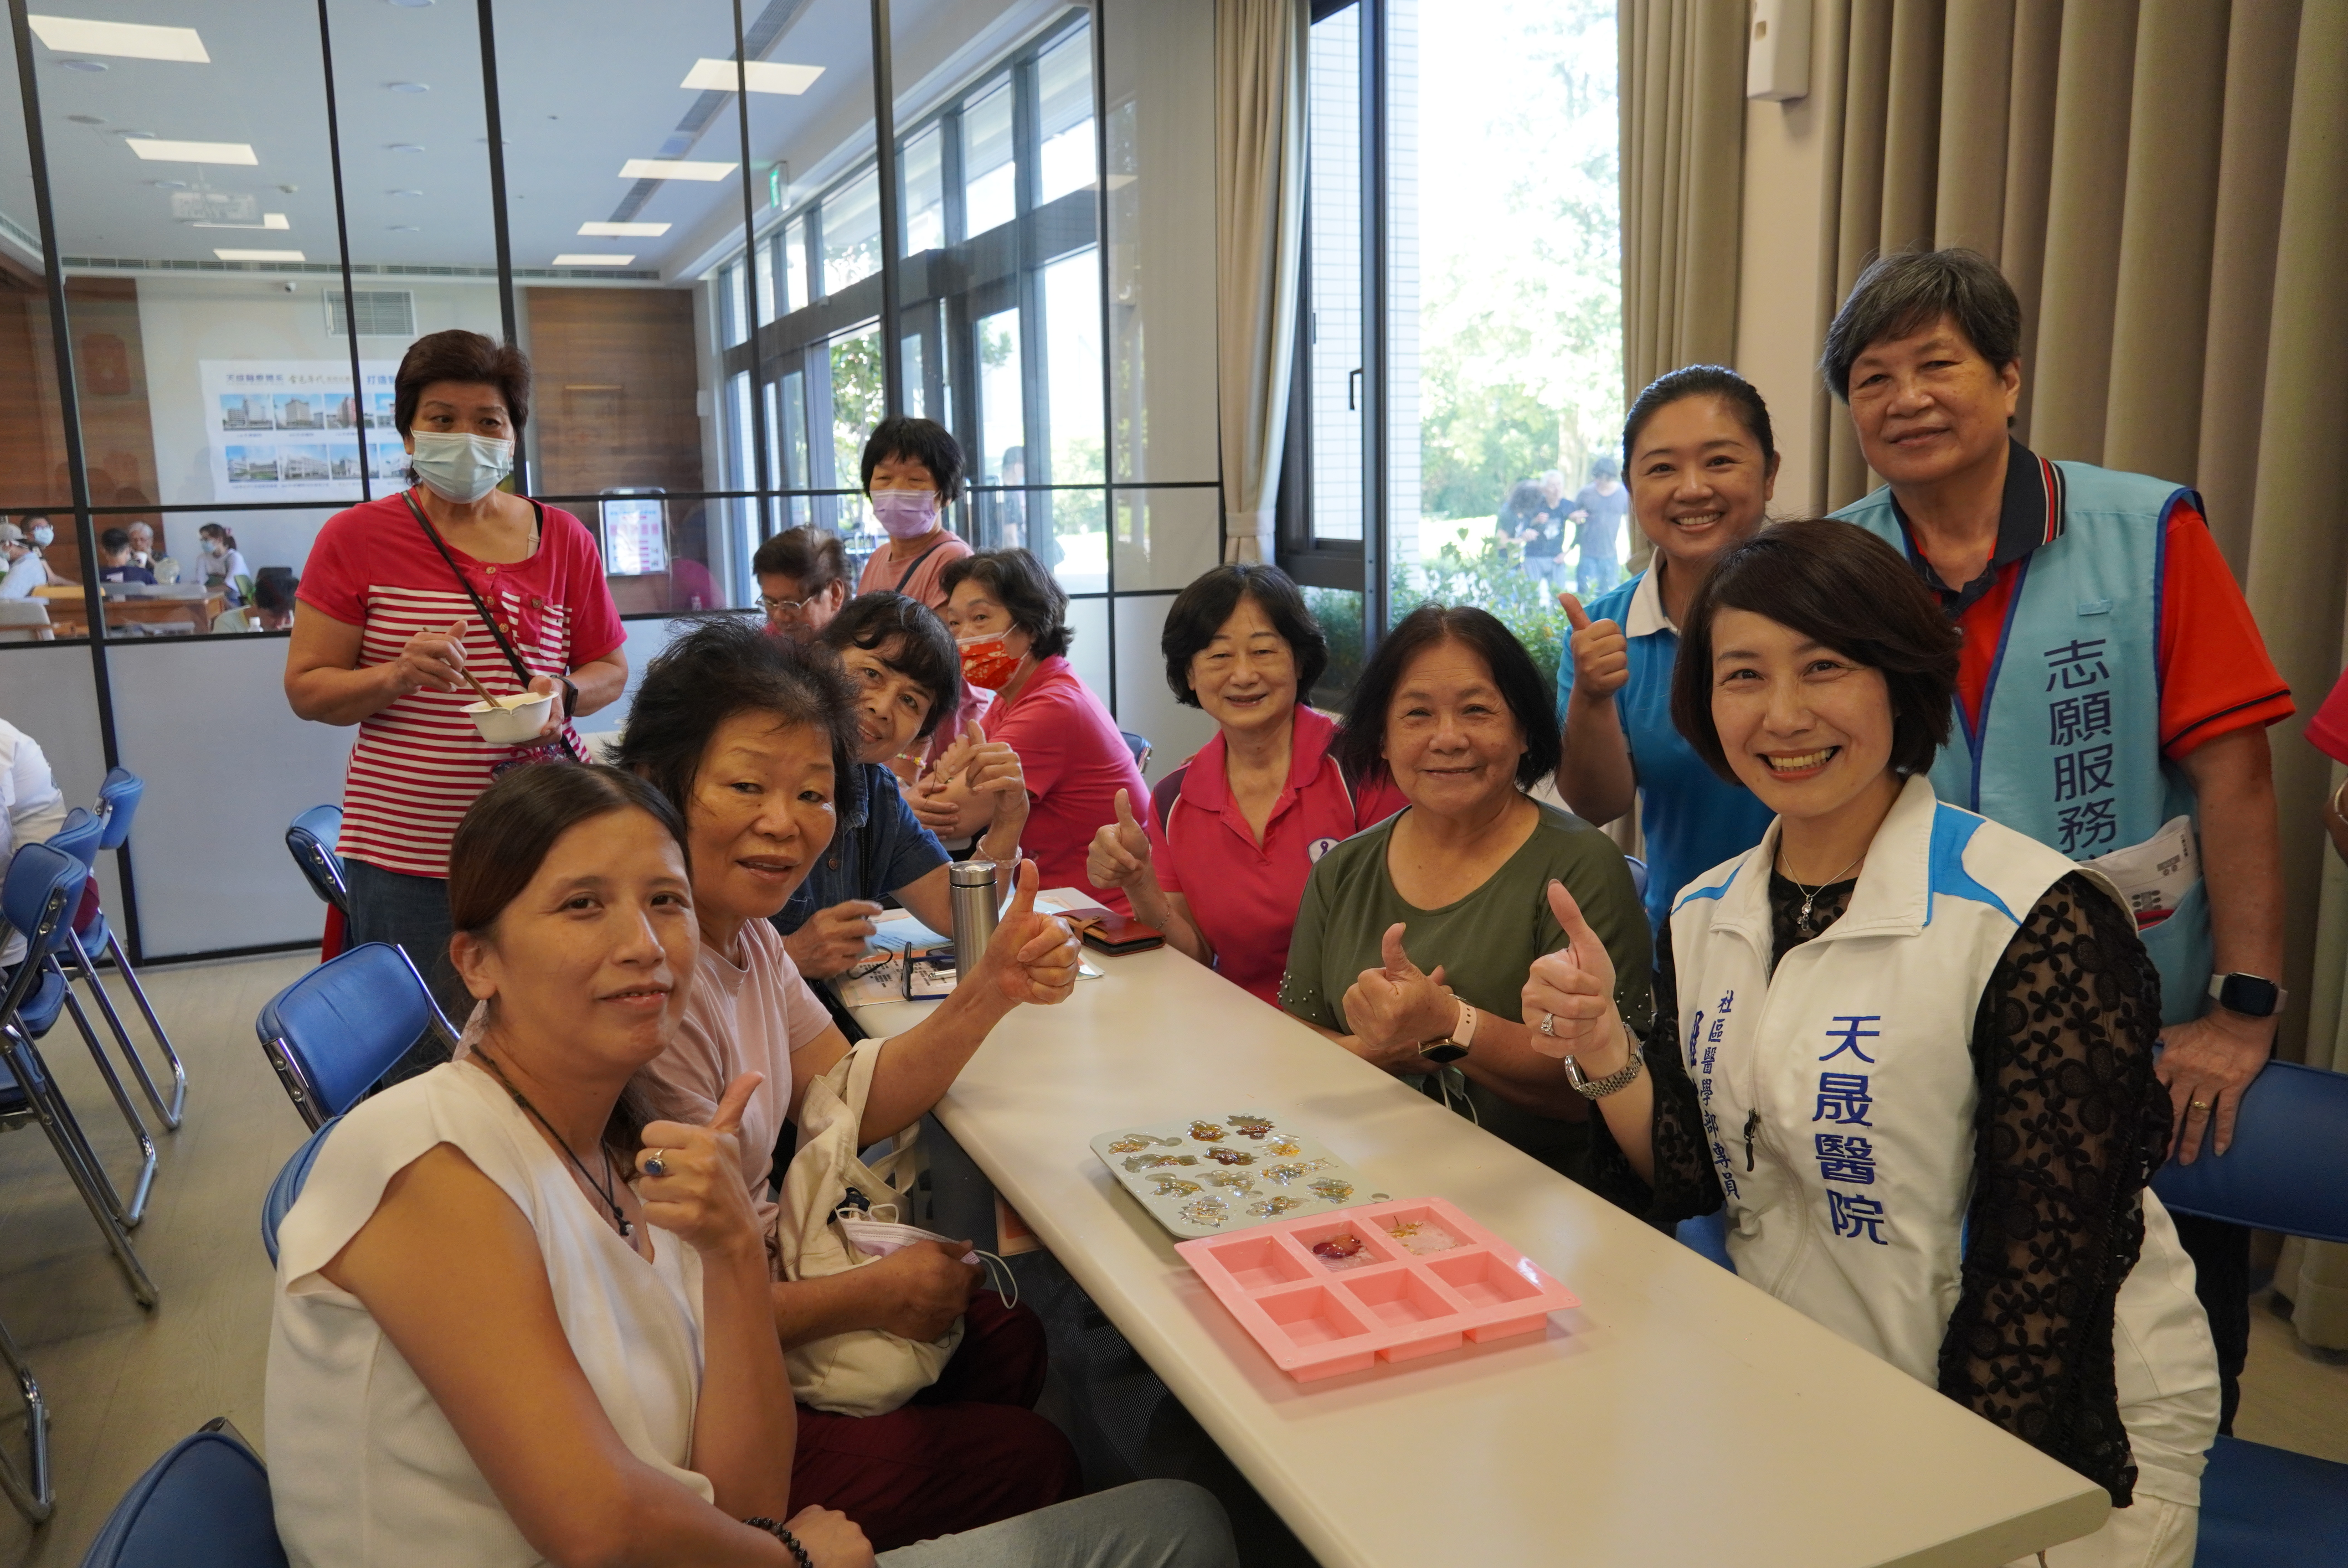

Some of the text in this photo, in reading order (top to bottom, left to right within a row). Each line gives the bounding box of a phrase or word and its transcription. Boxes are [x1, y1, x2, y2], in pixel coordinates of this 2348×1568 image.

[2043, 638, 2117, 862] 志願服務
[1700, 990, 1740, 1200] 社區醫學部專員
[1812, 1015, 1888, 1245] 天晟醫院
